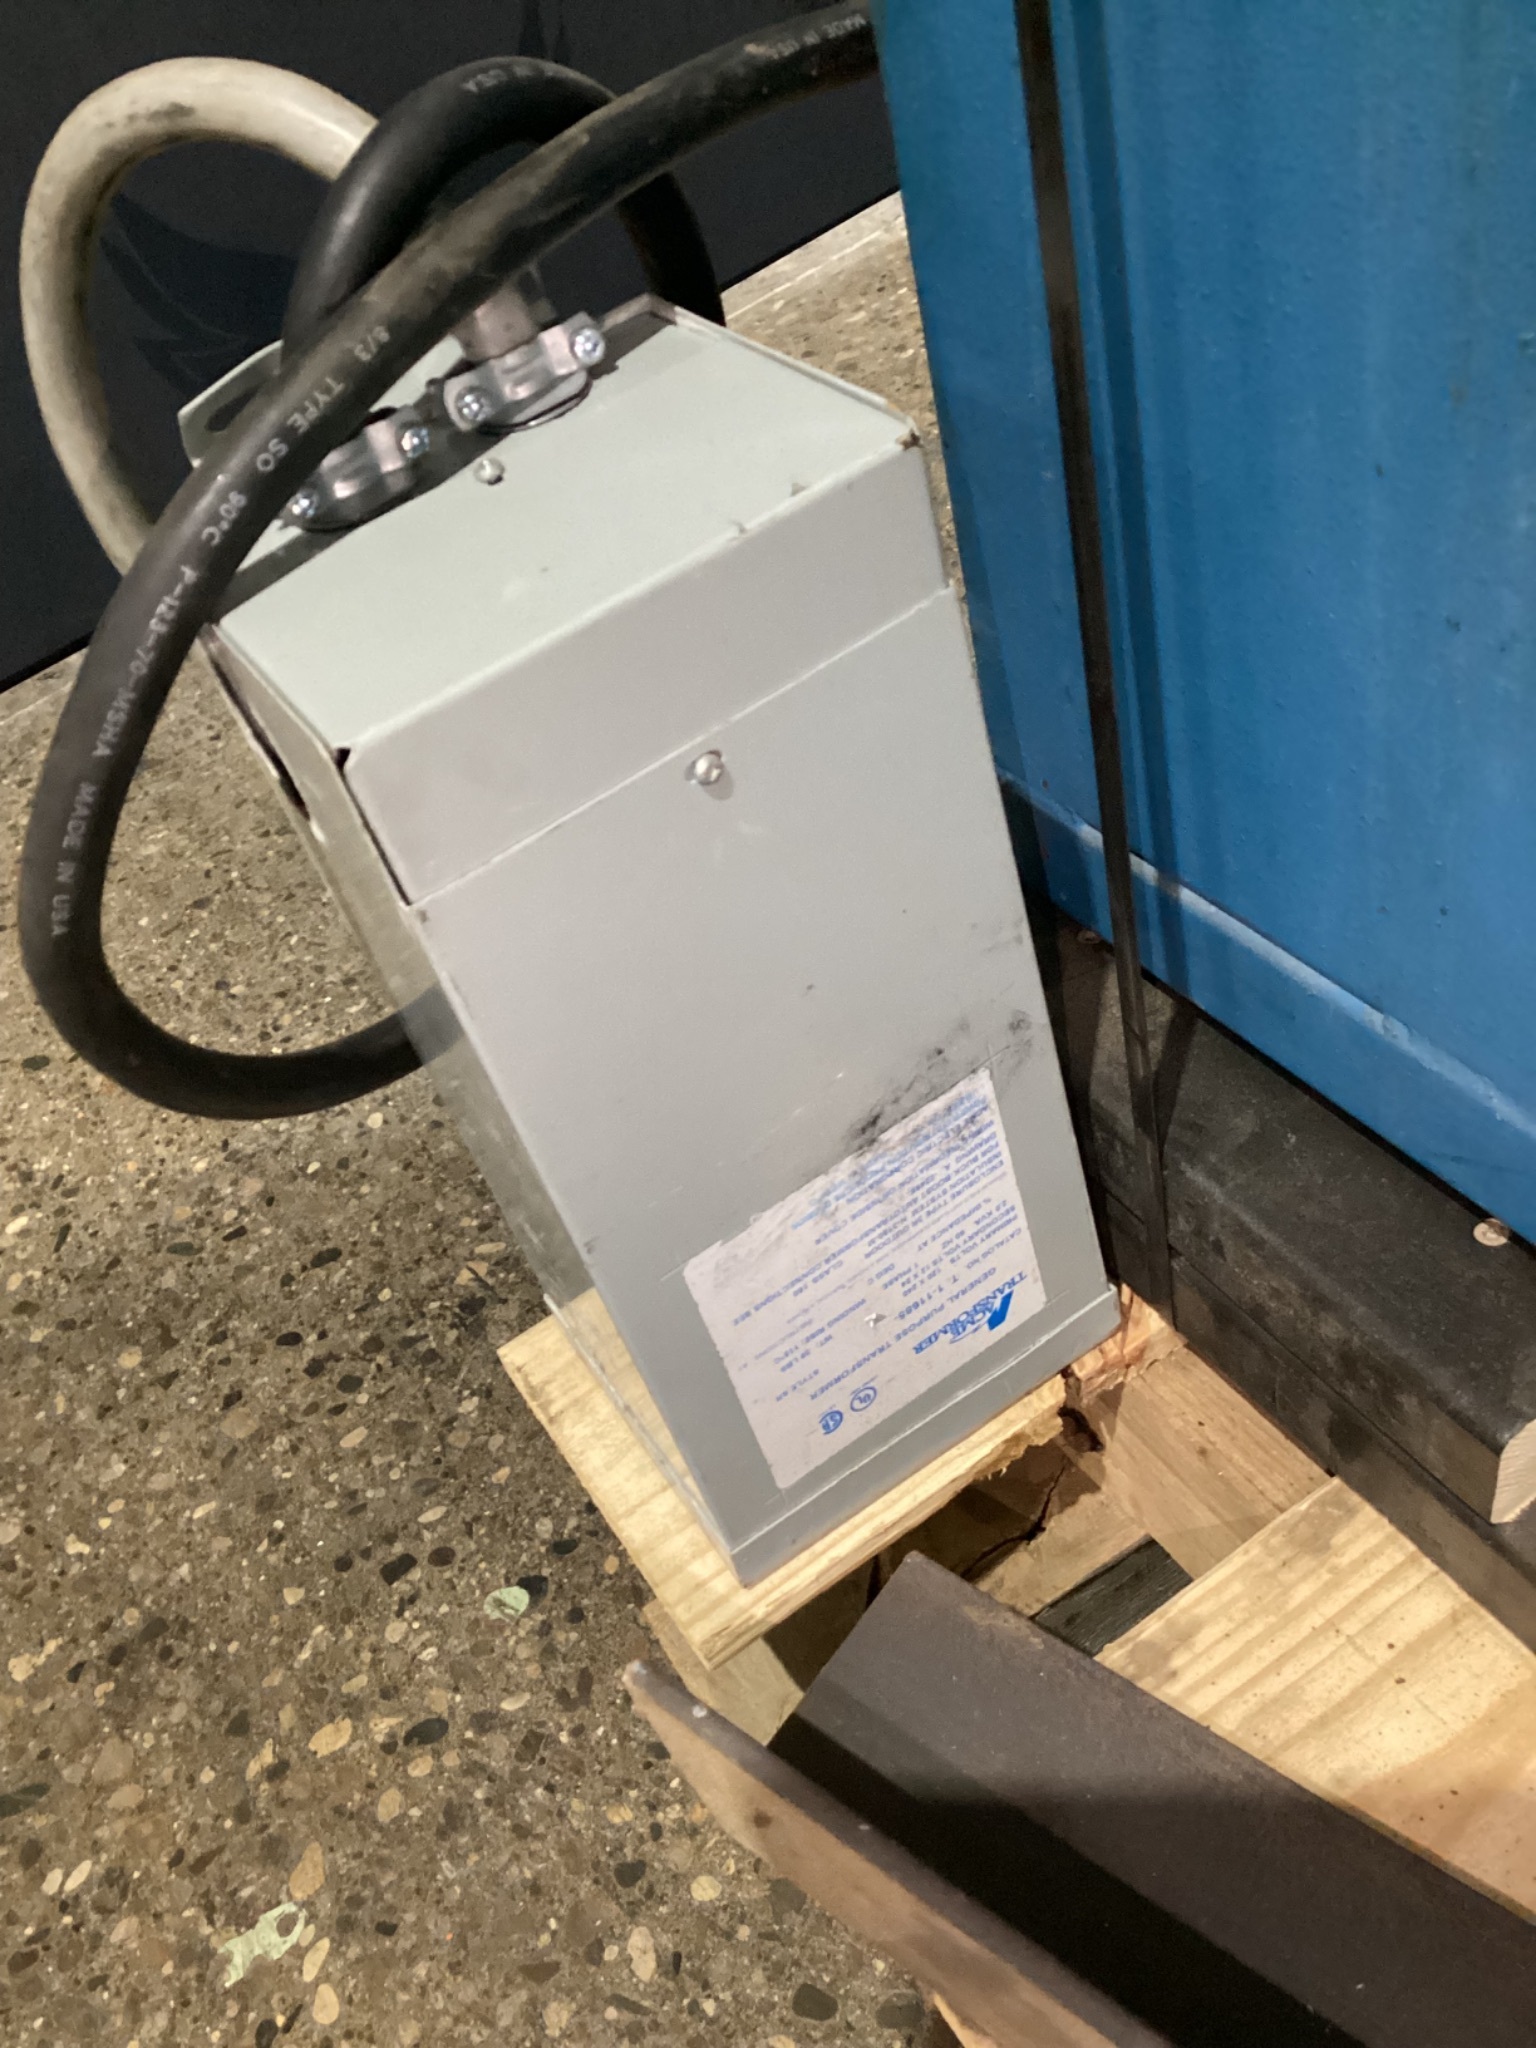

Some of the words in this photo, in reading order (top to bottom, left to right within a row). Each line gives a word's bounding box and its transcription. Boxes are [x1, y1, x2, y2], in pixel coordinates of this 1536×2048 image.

[354, 326, 391, 362] 8/3
[287, 377, 345, 433] TYPE
[257, 438, 289, 473] SO
[62, 782, 98, 848] MADE
[56, 861, 76, 883] IN
[51, 894, 72, 936] USA
[954, 1130, 997, 1164] DRAWING
[980, 1140, 999, 1157] FOR
[948, 1149, 1002, 1190] INSULATION
[949, 1158, 1004, 1201] ENCLOSURE
[910, 1187, 947, 1217] SYSTEM
[924, 1197, 948, 1218] TYPE
[973, 1209, 993, 1227] KVA
[822, 1195, 919, 1265] AUTOTRANSFORMER
[929, 1202, 982, 1242] IMPEDANCE
[962, 1204, 1015, 1244] SECONDARY
[979, 1213, 1018, 1244] PRIMARY
[863, 1223, 910, 1260] OUTDOOR
[916, 1239, 928, 1252] AT
[931, 1242, 960, 1266] VOLTS
[940, 1236, 953, 1250] HZ
[948, 1240, 978, 1265] VOLTS
[980, 1226, 1021, 1260] CATALOG
[752, 1261, 822, 1313] CONNECTIONS
[811, 1258, 843, 1285] CLASS
[866, 1276, 874, 1286] C
[874, 1262, 895, 1280] DEG
[881, 1265, 912, 1291] PHASE
[946, 1265, 996, 1305] GENERAL
[826, 1297, 866, 1328] WINDING
[893, 1302, 945, 1342] PURPOSE
[911, 1269, 1027, 1357] TRANSFORMER
[949, 1301, 996, 1340] ACME
[790, 1367, 819, 1392] STYLE
[808, 1339, 891, 1401] TRANSFORMER
